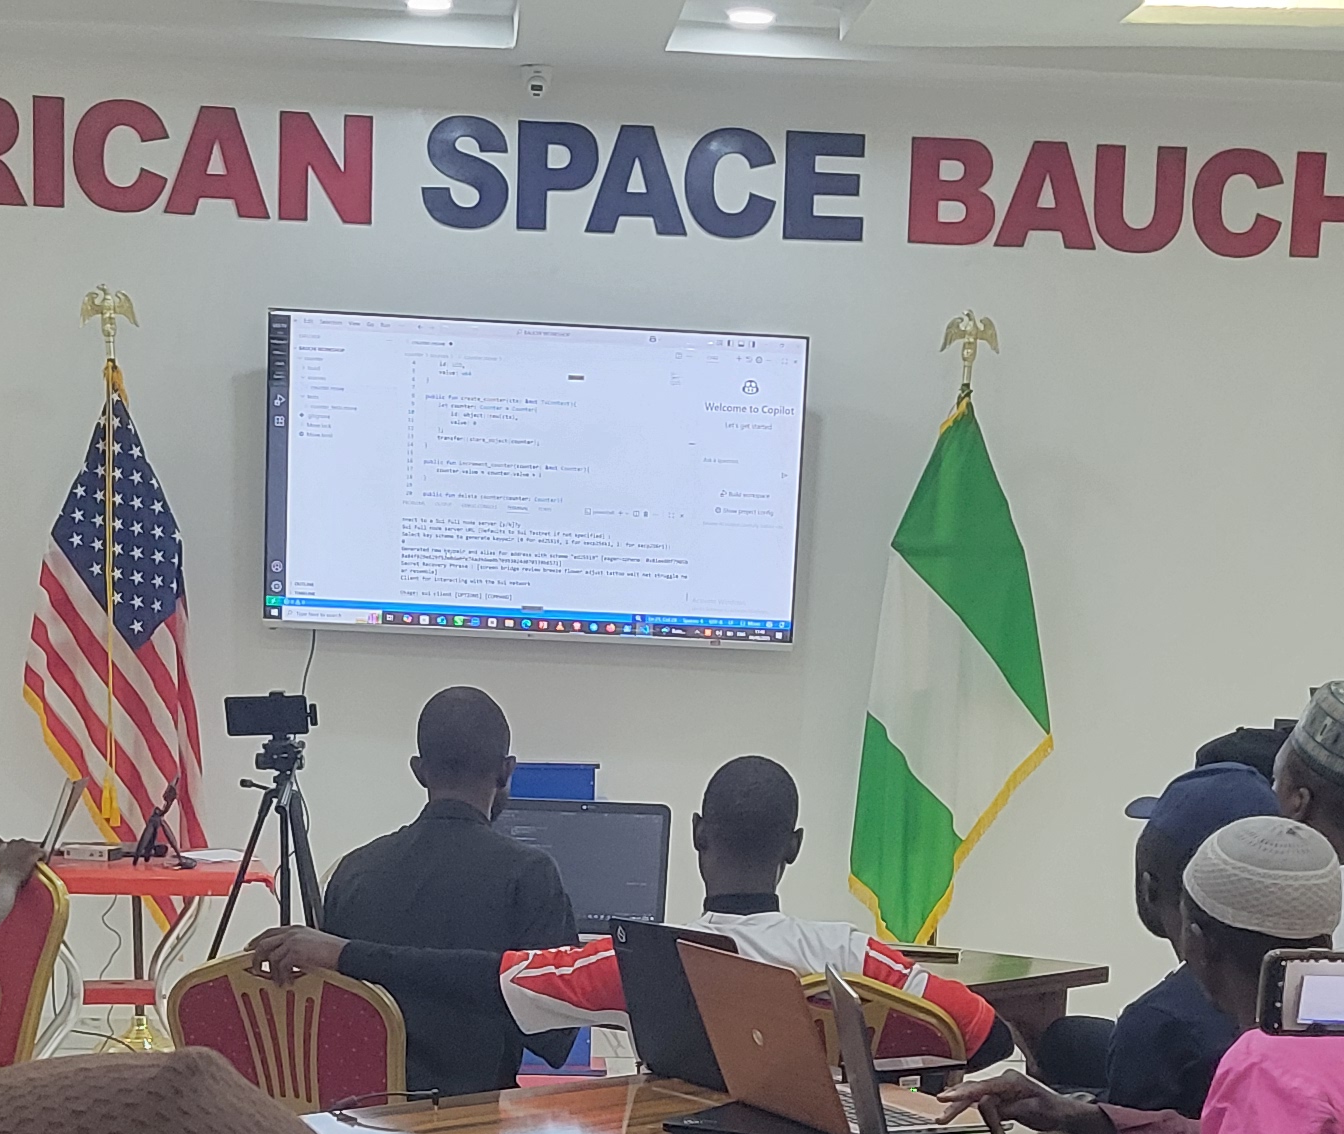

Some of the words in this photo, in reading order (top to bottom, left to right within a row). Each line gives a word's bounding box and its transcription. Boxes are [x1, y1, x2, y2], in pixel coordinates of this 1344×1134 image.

[422, 115, 867, 242] SPACE
[705, 402, 747, 413] Welcome
[749, 405, 759, 413] to
[761, 405, 795, 416] Copilot
